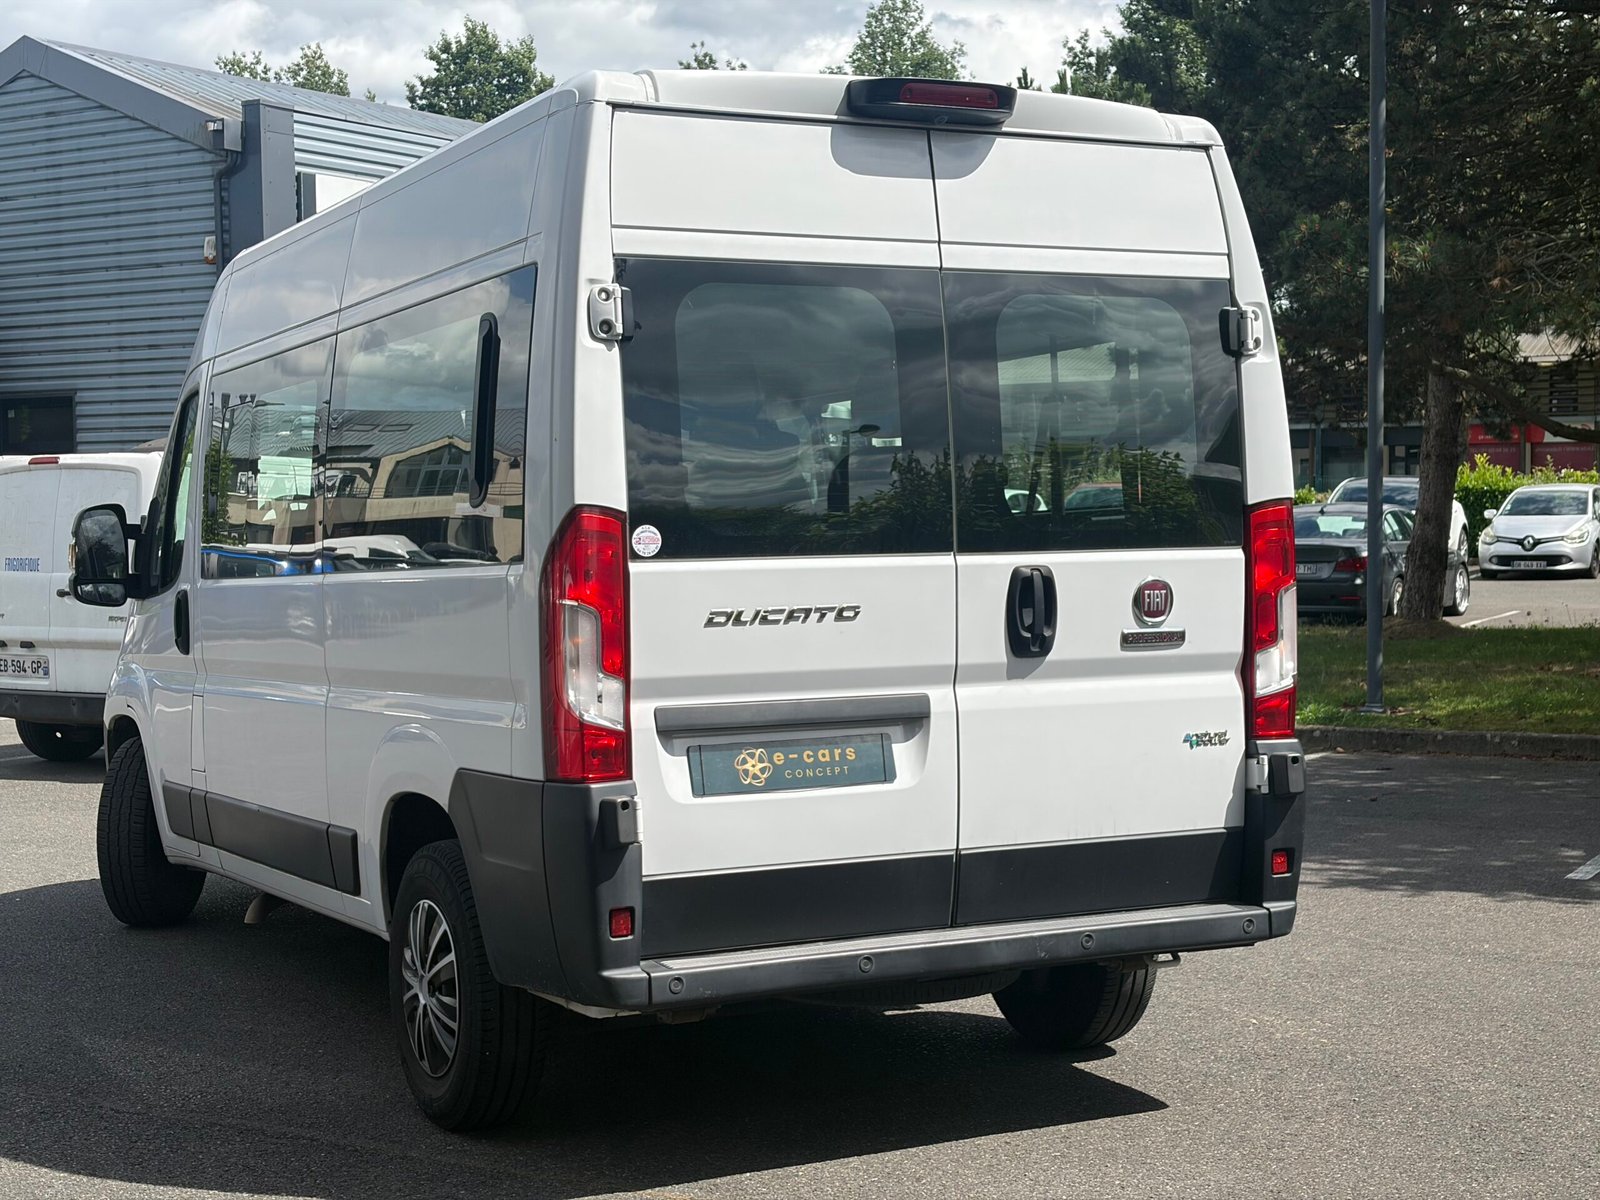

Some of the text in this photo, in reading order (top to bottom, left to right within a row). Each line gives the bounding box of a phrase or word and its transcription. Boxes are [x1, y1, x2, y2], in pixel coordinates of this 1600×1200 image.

[5, 557, 40, 571] FRIGORIFIQUE
[1144, 590, 1166, 611] FIAT
[703, 604, 862, 628] DUCATO
[772, 747, 856, 765] e-cars
[784, 765, 850, 779] CONCEPT
